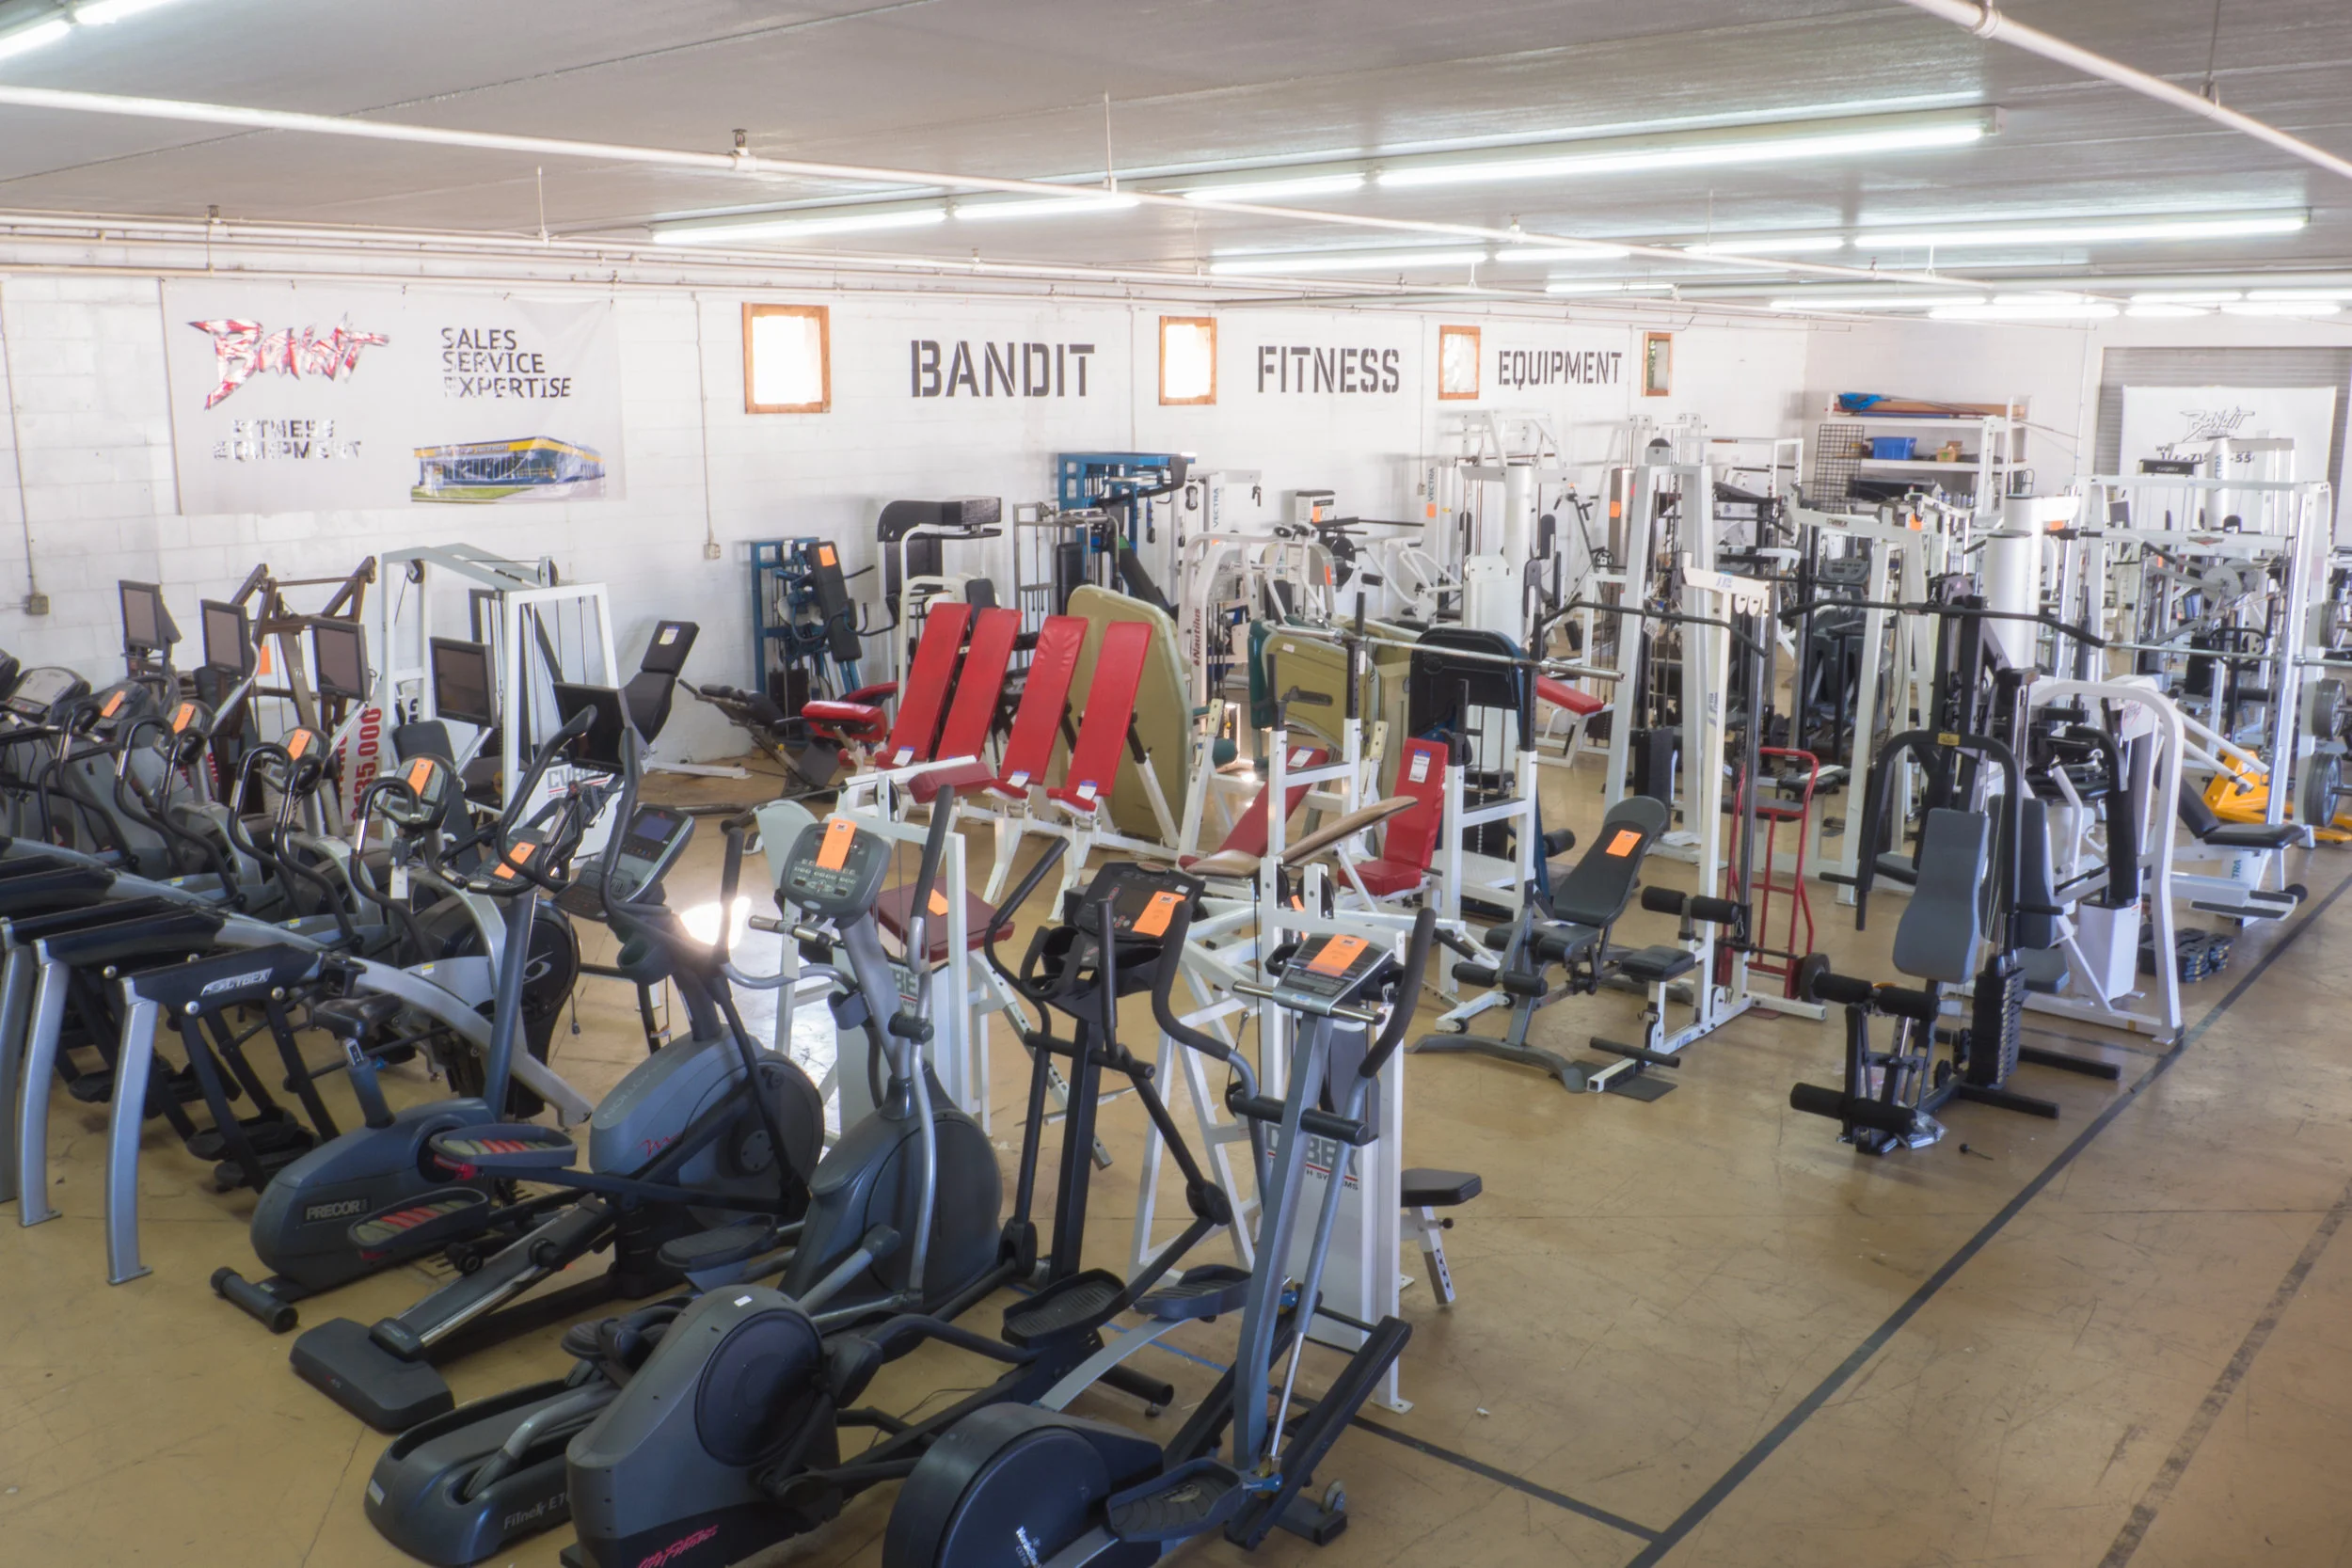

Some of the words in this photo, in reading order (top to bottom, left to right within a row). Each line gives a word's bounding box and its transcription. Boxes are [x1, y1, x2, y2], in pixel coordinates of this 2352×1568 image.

[440, 327, 517, 350] SALES
[442, 351, 546, 373] SERVICE
[911, 340, 1095, 398] BANDIT
[1258, 345, 1400, 393] FITNESS
[1498, 350, 1623, 391] EQUIPMENT
[443, 375, 572, 398] EXPERTISE
[1191, 609, 1201, 658] Nautilus
[306, 1199, 360, 1220] PRECOR
